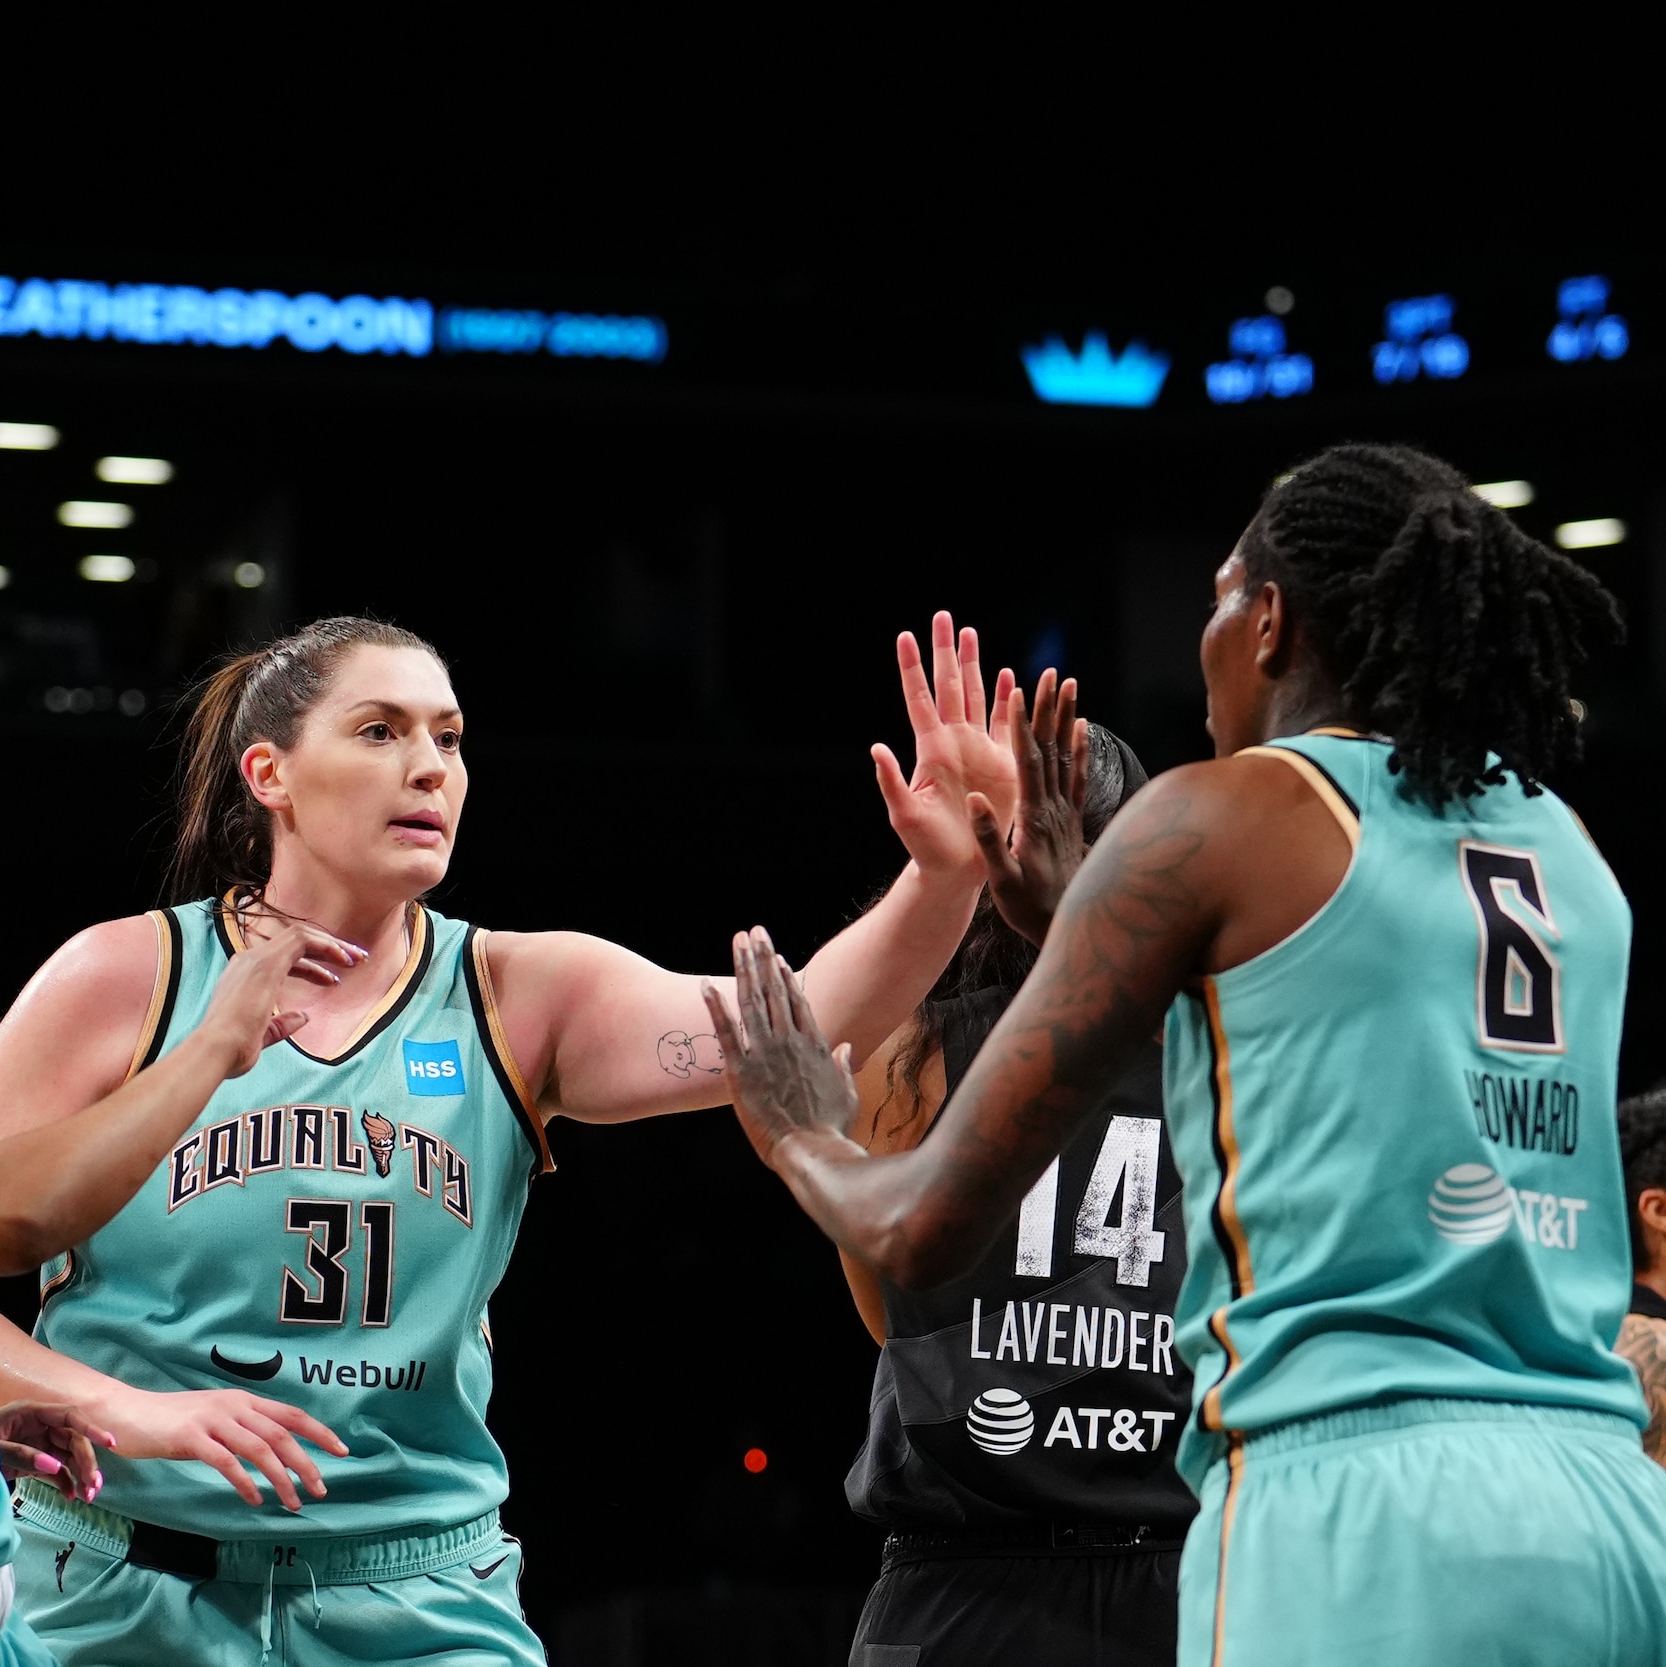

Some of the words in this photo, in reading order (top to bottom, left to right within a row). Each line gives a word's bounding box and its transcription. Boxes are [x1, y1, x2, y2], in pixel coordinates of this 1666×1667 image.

[1458, 839, 1567, 1054] 6
[409, 1059, 457, 1079] HSS
[1464, 1070, 1579, 1157] HOWARD
[1013, 1114, 1166, 1288] 14
[279, 1198, 395, 1328] 31
[299, 1355, 427, 1392] Webull
[970, 1298, 1176, 1376] LAVENDER
[1044, 1407, 1176, 1453] AT&T
